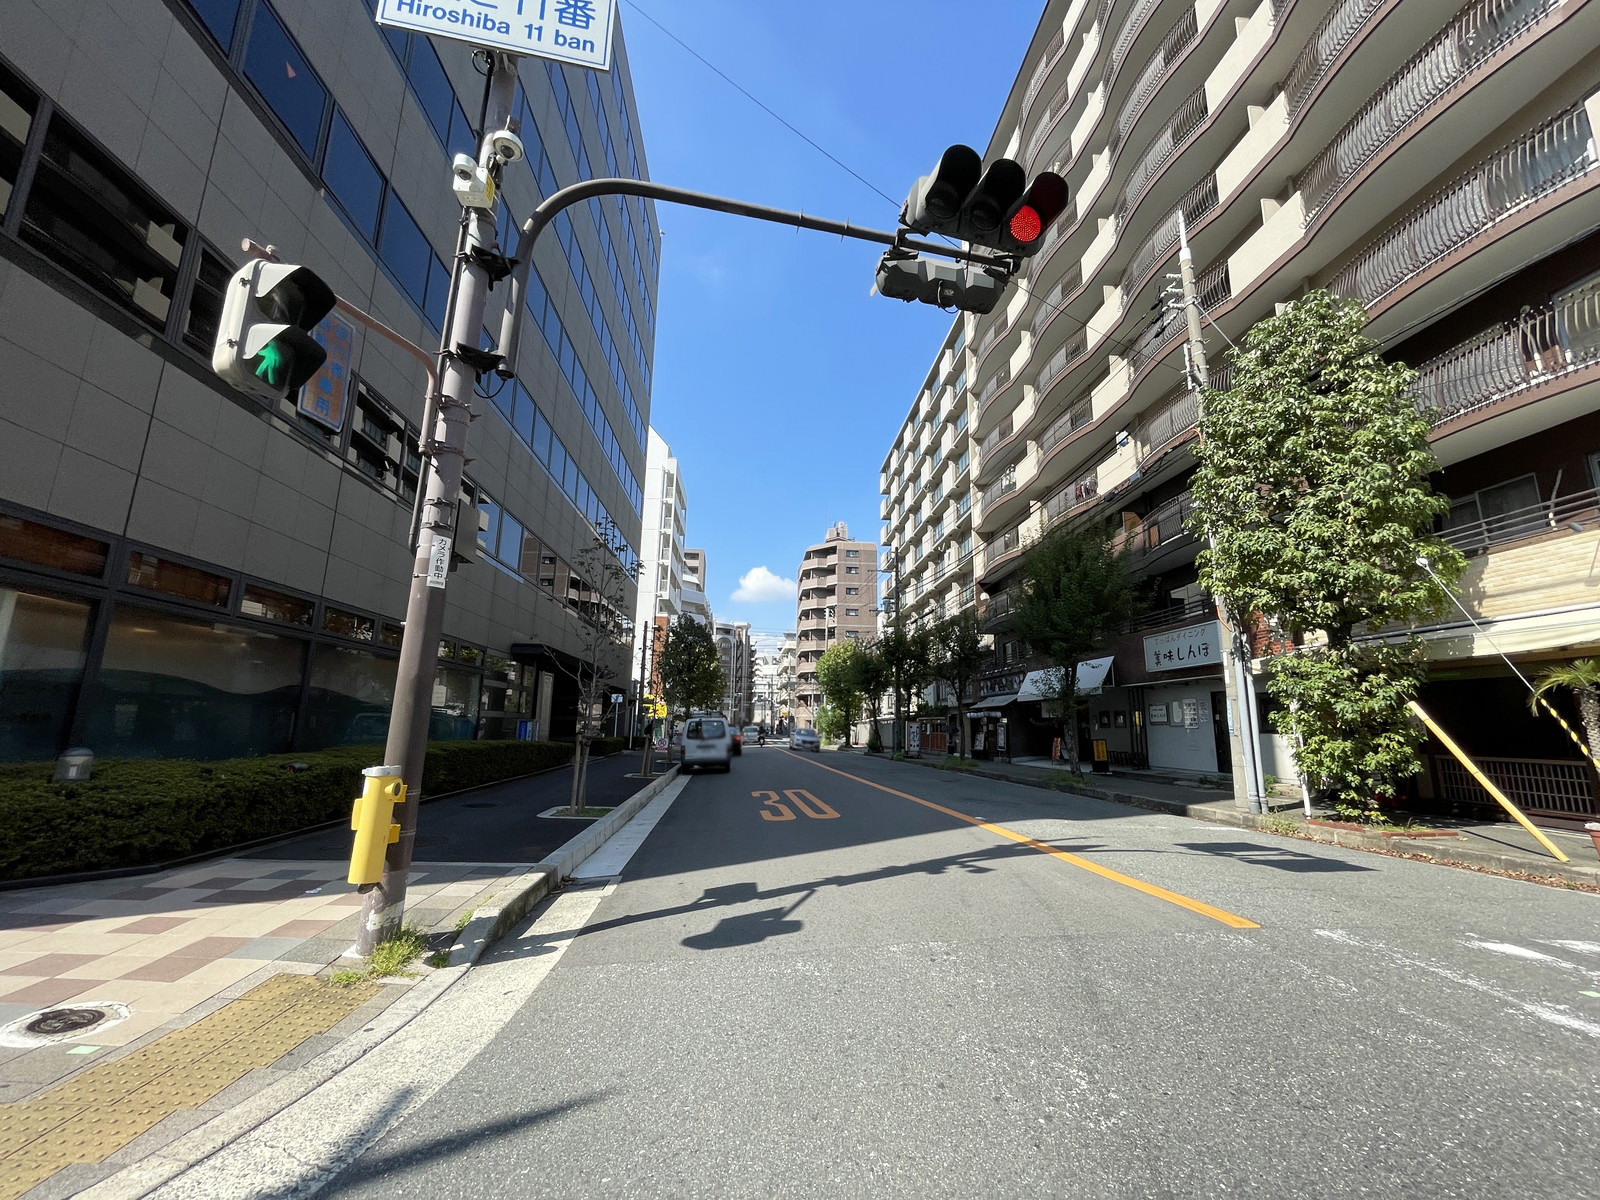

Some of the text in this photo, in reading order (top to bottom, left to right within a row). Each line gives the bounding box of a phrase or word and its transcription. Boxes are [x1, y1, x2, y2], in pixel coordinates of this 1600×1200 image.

[396, 0, 595, 53] Hiroshiba 11 ban
[434, 538, 446, 579] カメラ作動中
[751, 788, 841, 822] 30
